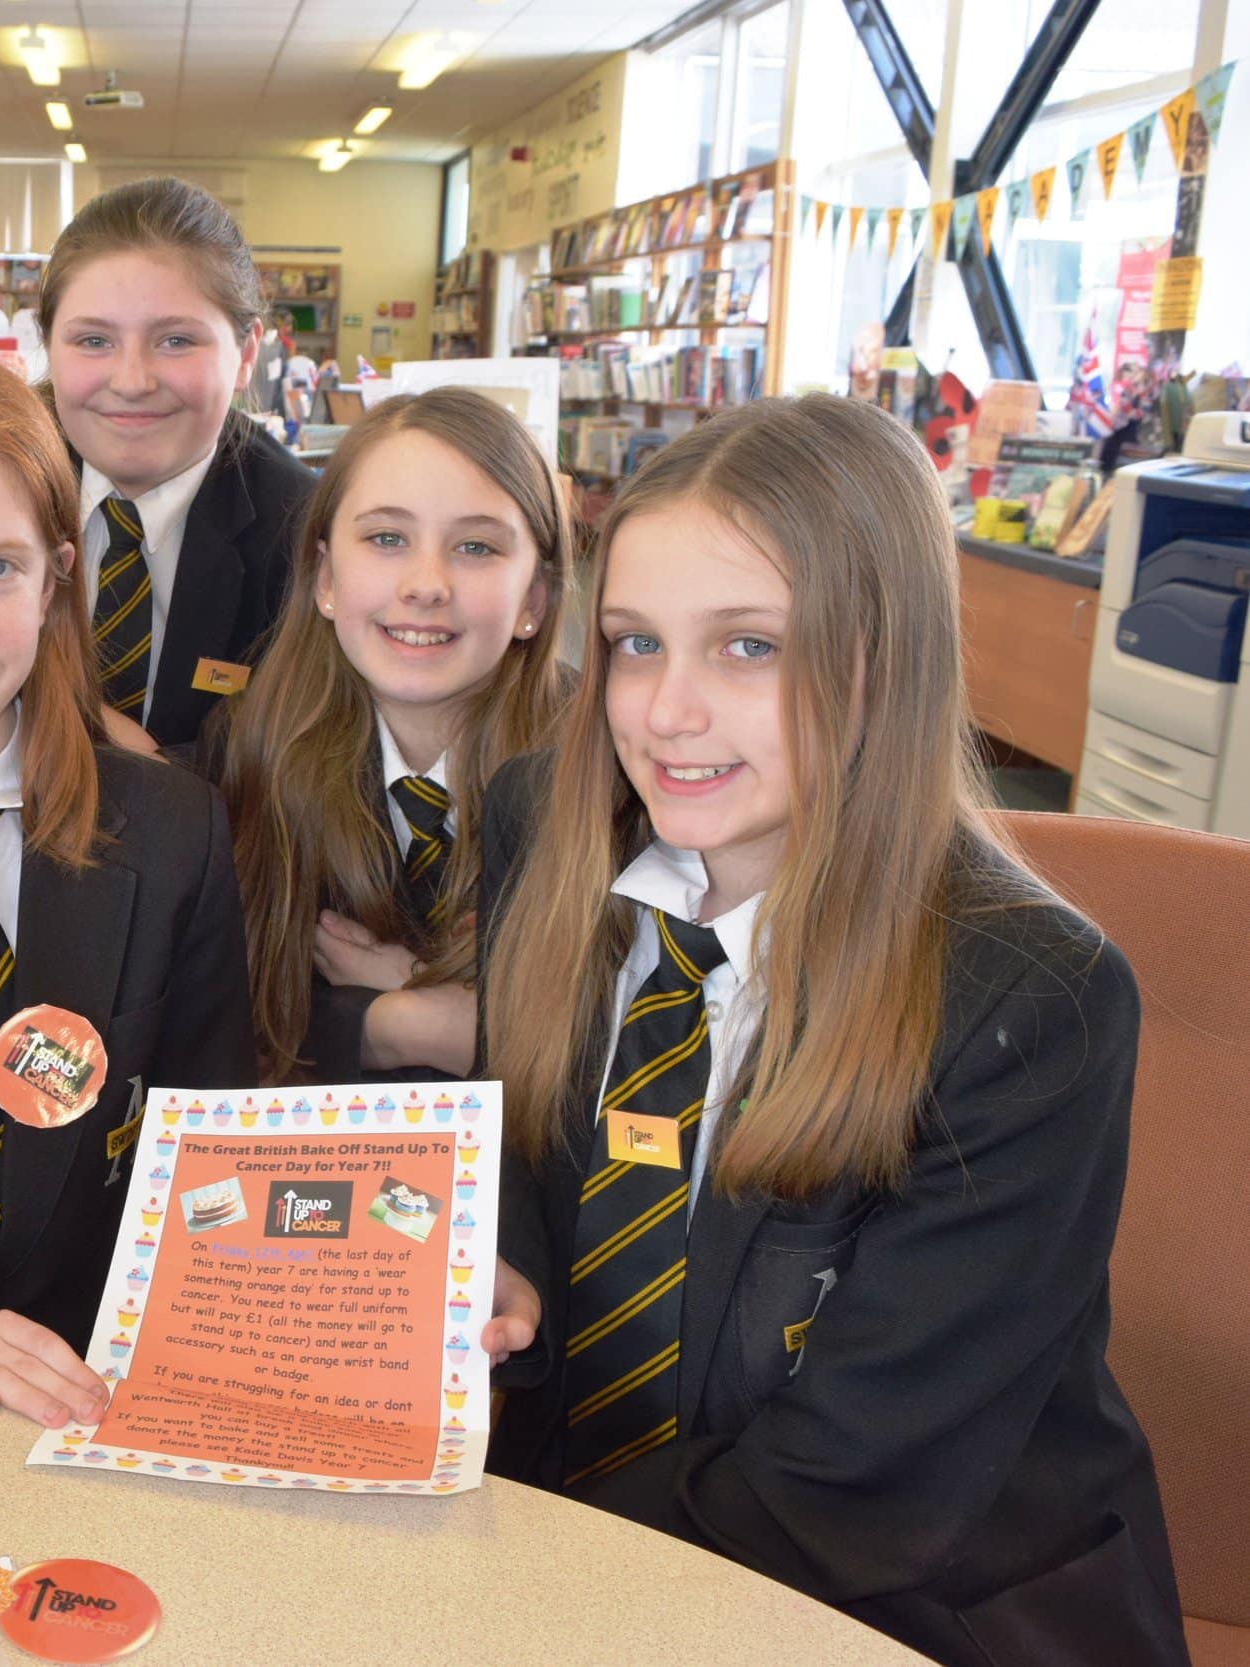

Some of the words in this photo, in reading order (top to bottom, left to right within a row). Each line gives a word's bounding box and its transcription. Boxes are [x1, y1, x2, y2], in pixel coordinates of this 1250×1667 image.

[31, 1056, 50, 1073] UP
[35, 1047, 78, 1078] STAND
[24, 1068, 79, 1108] CANCER
[185, 1143, 209, 1154] The
[213, 1144, 250, 1155] Great
[254, 1144, 297, 1155] British
[301, 1144, 334, 1155] Bake
[338, 1144, 360, 1154] Off
[363, 1144, 404, 1154] Stand
[408, 1144, 428, 1156] Up
[432, 1143, 450, 1154] To
[236, 1161, 282, 1172] Cancer
[285, 1161, 311, 1174] Day
[315, 1161, 334, 1171] for
[338, 1161, 369, 1171] Year
[373, 1161, 391, 1171] 7!!
[293, 1210, 309, 1220] UP
[309, 1210, 325, 1220] TO
[294, 1199, 332, 1211] STAND
[292, 1220, 341, 1232] CANCER
[191, 1240, 207, 1252] On
[317, 1248, 341, 1261] (the
[347, 1249, 368, 1260] last
[373, 1250, 393, 1262] day
[398, 1250, 412, 1260] of
[191, 1258, 214, 1269] this
[219, 1260, 252, 1273] term)
[256, 1265, 282, 1276] year
[288, 1265, 295, 1275] 7
[299, 1267, 318, 1276] are
[323, 1267, 359, 1280] having
[363, 1270, 370, 1278] a
[183, 1273, 242, 1290] something
[247, 1282, 286, 1295] orange
[319, 1283, 337, 1294] for
[342, 1285, 374, 1295] stand
[378, 1287, 392, 1298] up
[397, 1286, 410, 1296] to
[181, 1289, 223, 1303] cancer.
[230, 1293, 251, 1306] You
[256, 1299, 284, 1309] need
[290, 1301, 302, 1311] to
[306, 1303, 334, 1312] wear
[339, 1301, 358, 1313] full
[362, 1303, 408, 1315] uniform
[171, 1302, 191, 1313] but
[195, 1307, 215, 1317] will
[219, 1311, 240, 1321] pay
[246, 1312, 262, 1323] £1
[268, 1315, 287, 1327] (all
[293, 1317, 312, 1329] the
[317, 1320, 353, 1332] money
[357, 1320, 377, 1332] will
[381, 1324, 395, 1335] go
[400, 1323, 413, 1334] to
[190, 1322, 224, 1335] stand
[229, 1328, 243, 1339] up
[248, 1330, 261, 1341] to
[266, 1334, 310, 1348] cancer)
[315, 1338, 336, 1348] and
[340, 1339, 368, 1349] wear
[374, 1341, 388, 1350] an
[165, 1335, 225, 1352] accessory
[229, 1345, 257, 1357] such
[261, 1350, 275, 1360] as
[280, 1353, 295, 1362] an
[300, 1354, 339, 1368] orange
[344, 1356, 374, 1368] wrist
[379, 1358, 409, 1370] band
[254, 1365, 268, 1374] or
[273, 1366, 312, 1383] badge.
[153, 1365, 168, 1377] If
[173, 1371, 193, 1381] you
[198, 1375, 219, 1385] are
[223, 1379, 284, 1399] struggling
[290, 1388, 310, 1401] for
[315, 1395, 329, 1405] an
[335, 1395, 359, 1407] idea
[365, 1400, 379, 1408] or
[384, 1399, 413, 1412] dont
[131, 1393, 200, 1407] Wentworth
[206, 1403, 232, 1412] Hall
[200, 1412, 222, 1421] you
[227, 1416, 250, 1425] can
[254, 1420, 278, 1430] buy
[117, 1412, 131, 1420] If
[136, 1415, 158, 1423] you
[163, 1417, 194, 1427] want
[200, 1421, 214, 1430] to
[218, 1424, 250, 1434] bake
[255, 1429, 279, 1438] and
[285, 1434, 307, 1443] sell
[313, 1439, 346, 1449] some
[352, 1445, 395, 1458] treats
[400, 1456, 424, 1465] and
[126, 1424, 170, 1435] donate
[176, 1429, 197, 1439] the
[203, 1433, 246, 1444] money
[251, 1438, 272, 1447] the
[279, 1442, 316, 1454] stand
[321, 1450, 336, 1459] up
[343, 1452, 356, 1460] to
[362, 1456, 408, 1469] cancer
[159, 1438, 201, 1449] please
[206, 1444, 229, 1452] see
[278, 1452, 313, 1464] Davis
[320, 1458, 351, 1469] Year
[49, 1599, 76, 1613] UP
[52, 1589, 117, 1611] STAND
[44, 1611, 129, 1637] CANCER
